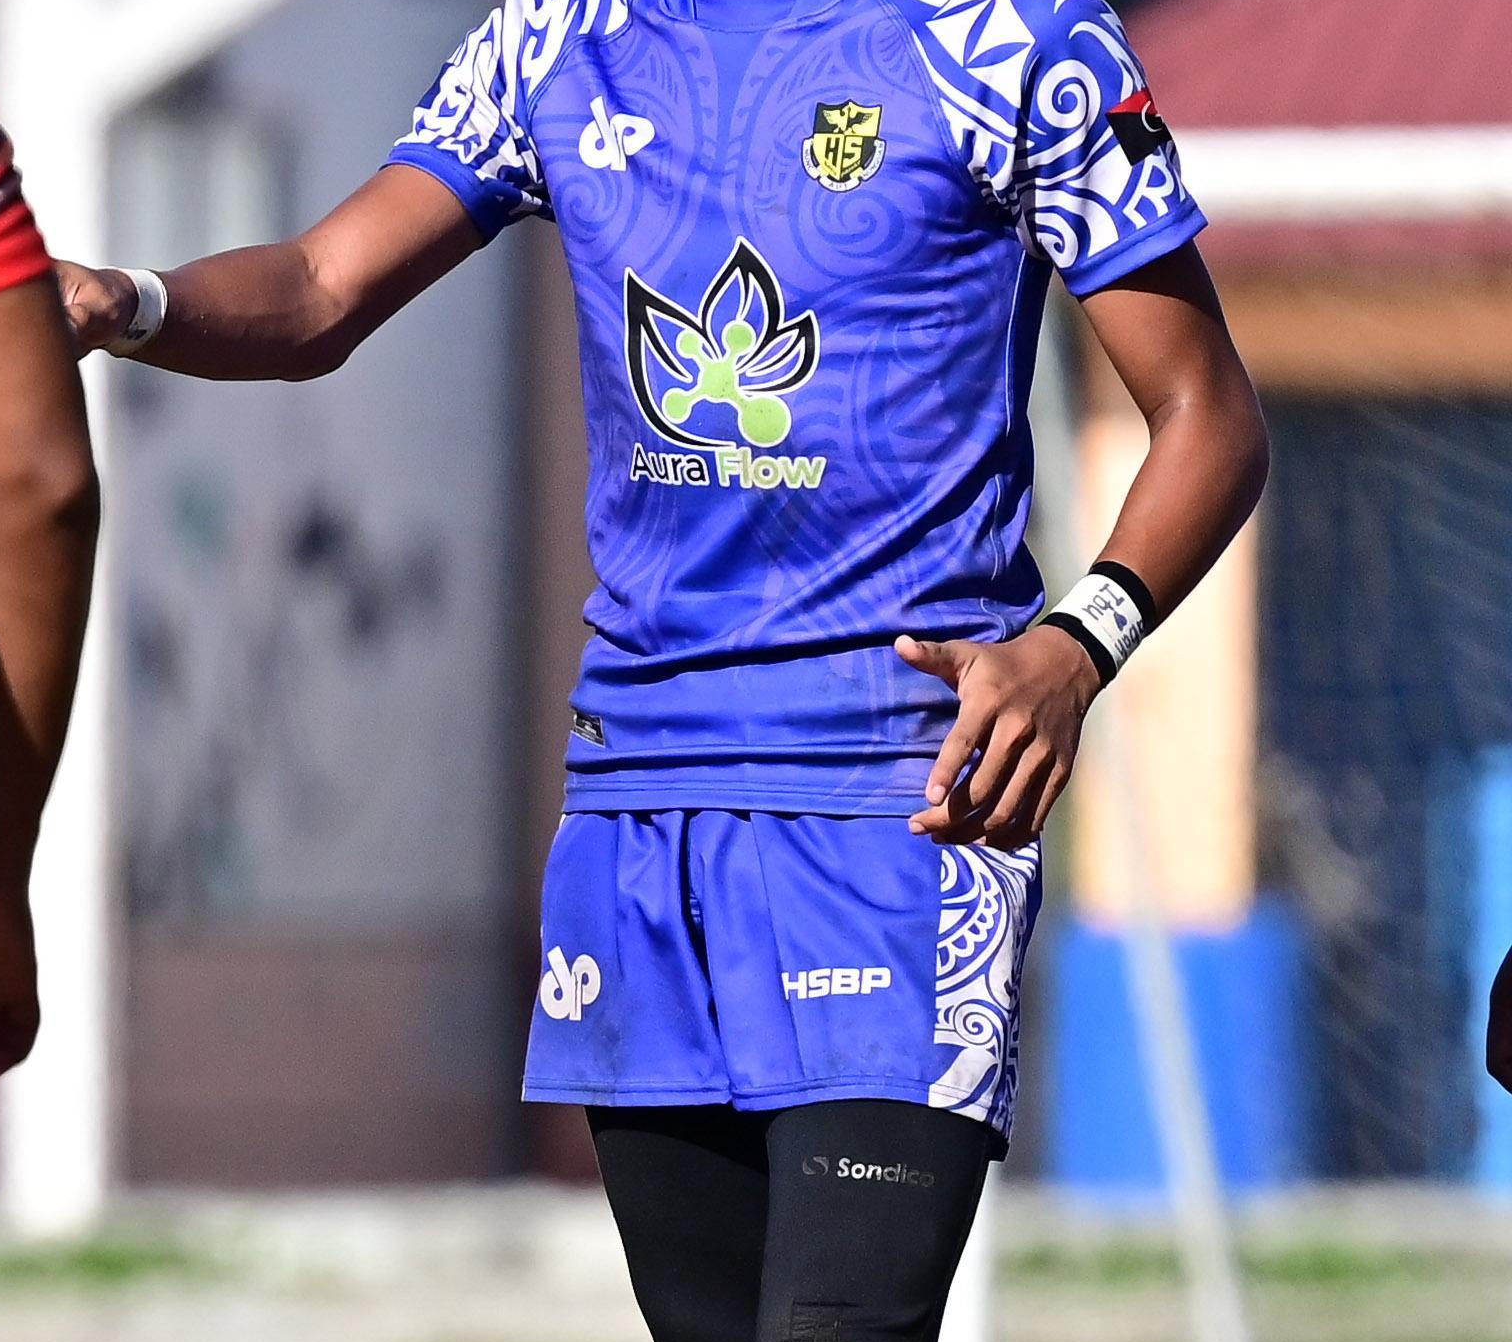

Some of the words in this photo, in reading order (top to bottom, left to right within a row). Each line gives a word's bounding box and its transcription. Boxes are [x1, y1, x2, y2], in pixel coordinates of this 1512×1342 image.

[630, 442, 710, 487] Aura
[714, 446, 827, 490] Flow
[781, 965, 892, 1002] HSBP
[836, 1156, 937, 1189] Sondico
